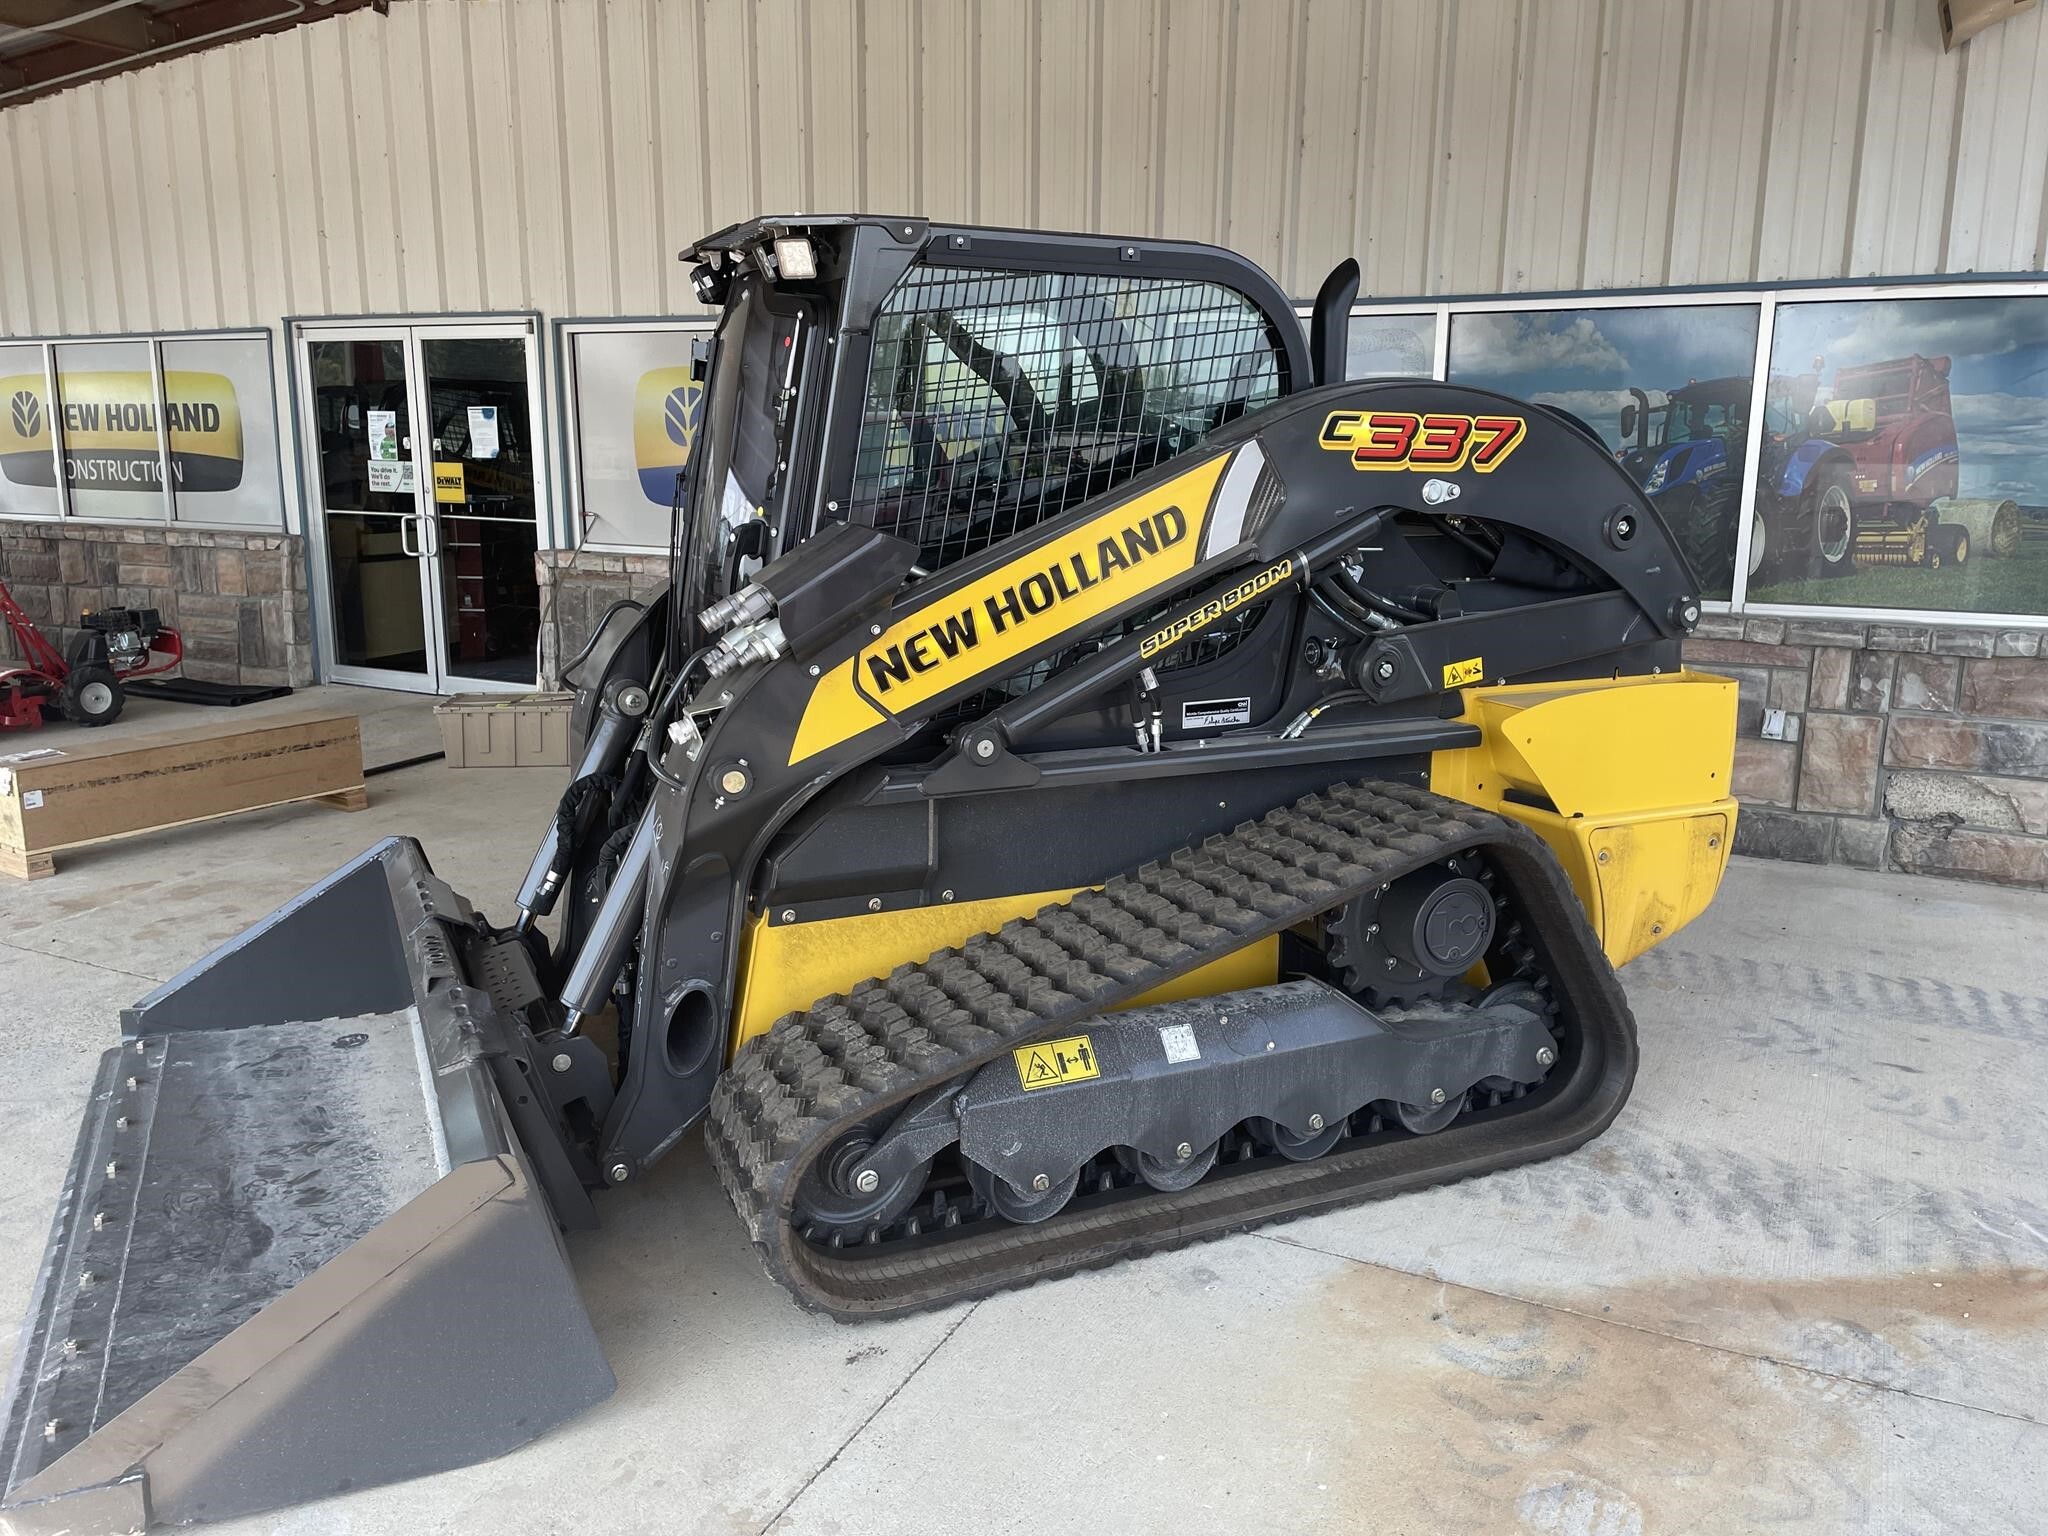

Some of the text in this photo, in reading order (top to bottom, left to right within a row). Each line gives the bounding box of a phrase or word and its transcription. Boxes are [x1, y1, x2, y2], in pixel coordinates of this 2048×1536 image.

[1320, 411, 1527, 473] C337
[866, 504, 1188, 693] NEW HOLLAND
[1141, 560, 1292, 658] SUPER BOOM
